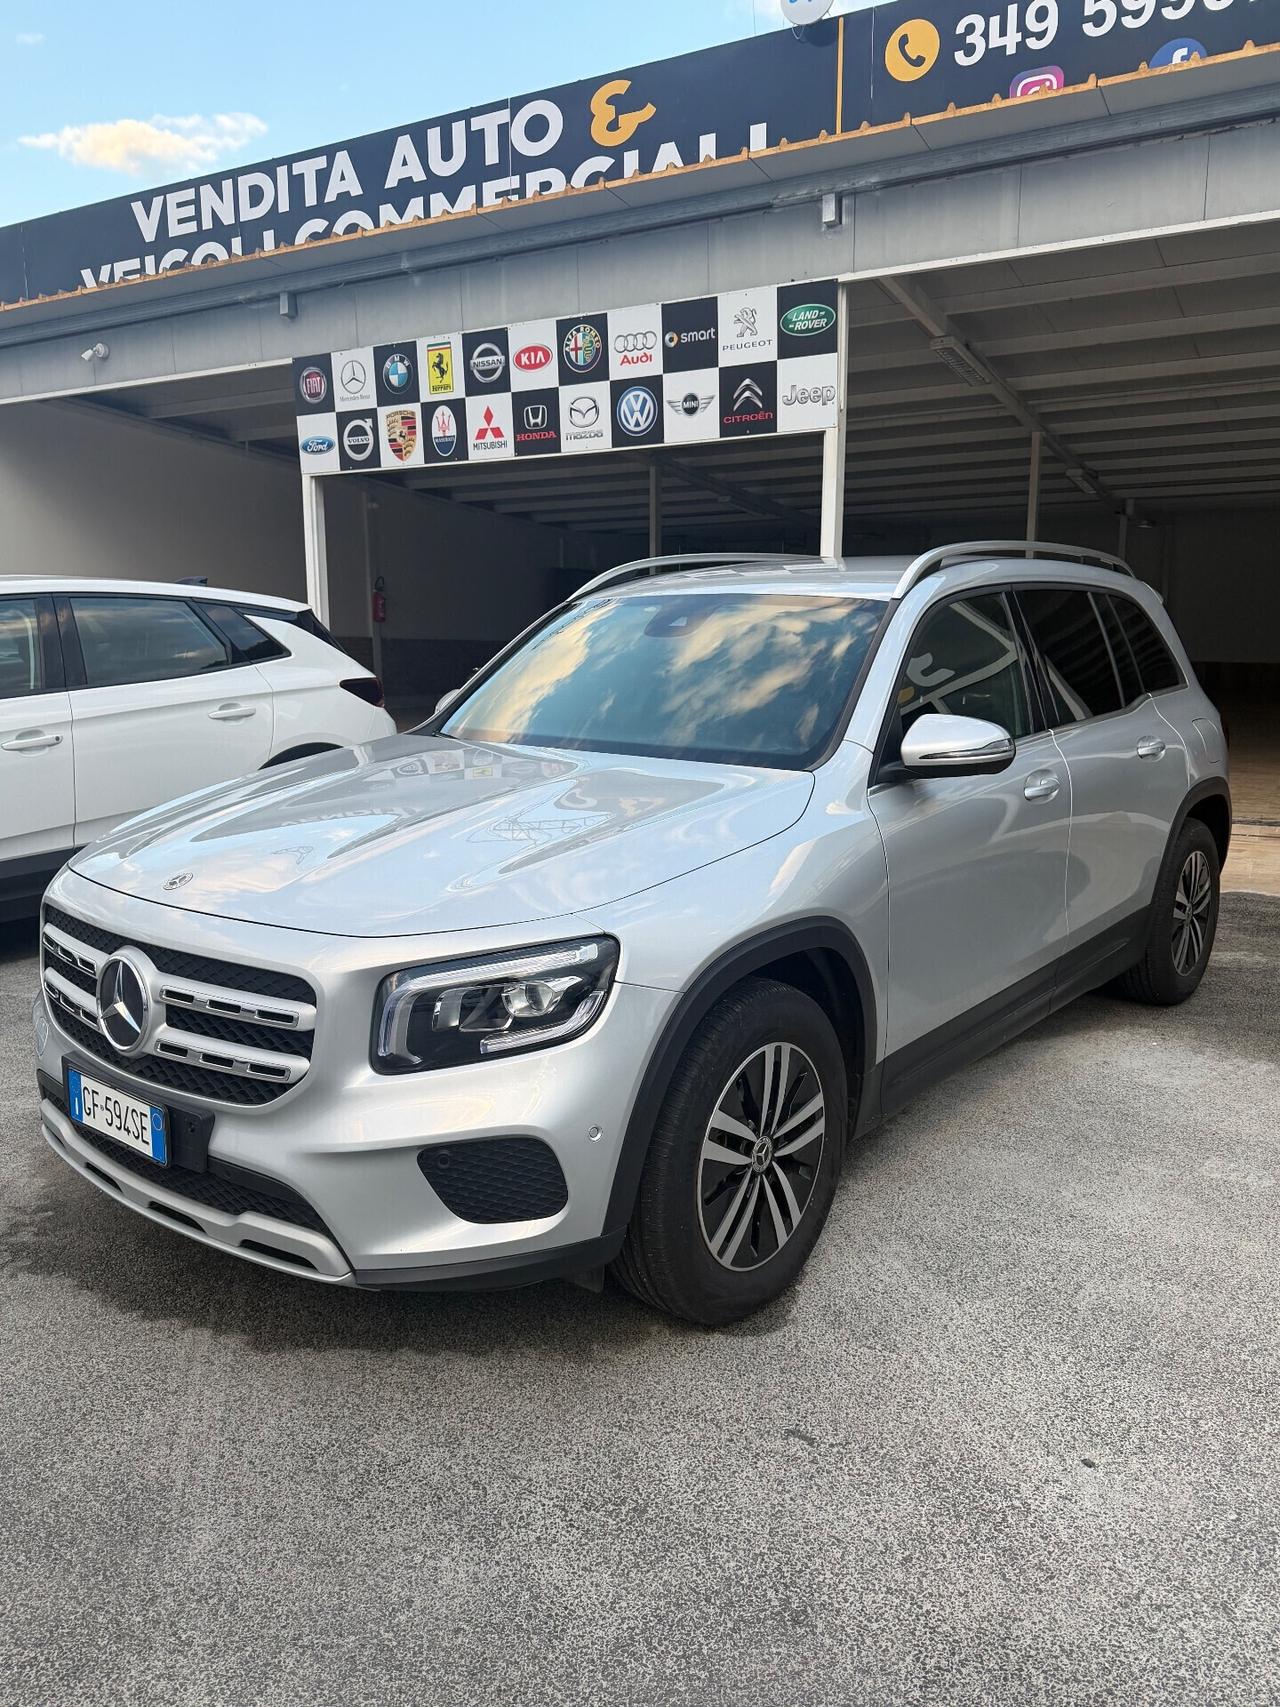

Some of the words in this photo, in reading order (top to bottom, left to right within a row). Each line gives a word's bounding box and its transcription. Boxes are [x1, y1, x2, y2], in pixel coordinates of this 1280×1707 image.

[953, 0, 1059, 66] 349
[130, 150, 364, 243] VENDITA
[384, 99, 564, 189] AUTO
[590, 79, 657, 147] &
[680, 327, 716, 343] smart
[722, 339, 773, 351] PEUGEOT
[473, 358, 502, 368] NISSAN
[520, 351, 545, 366] KIA
[620, 352, 652, 366] Audi
[306, 377, 321, 394] FIAT
[782, 384, 836, 406] Jeep
[682, 400, 699, 409] MINI
[516, 431, 557, 441] HONDA
[307, 440, 328, 452] Ford
[473, 440, 508, 451] MITSUBISHI
